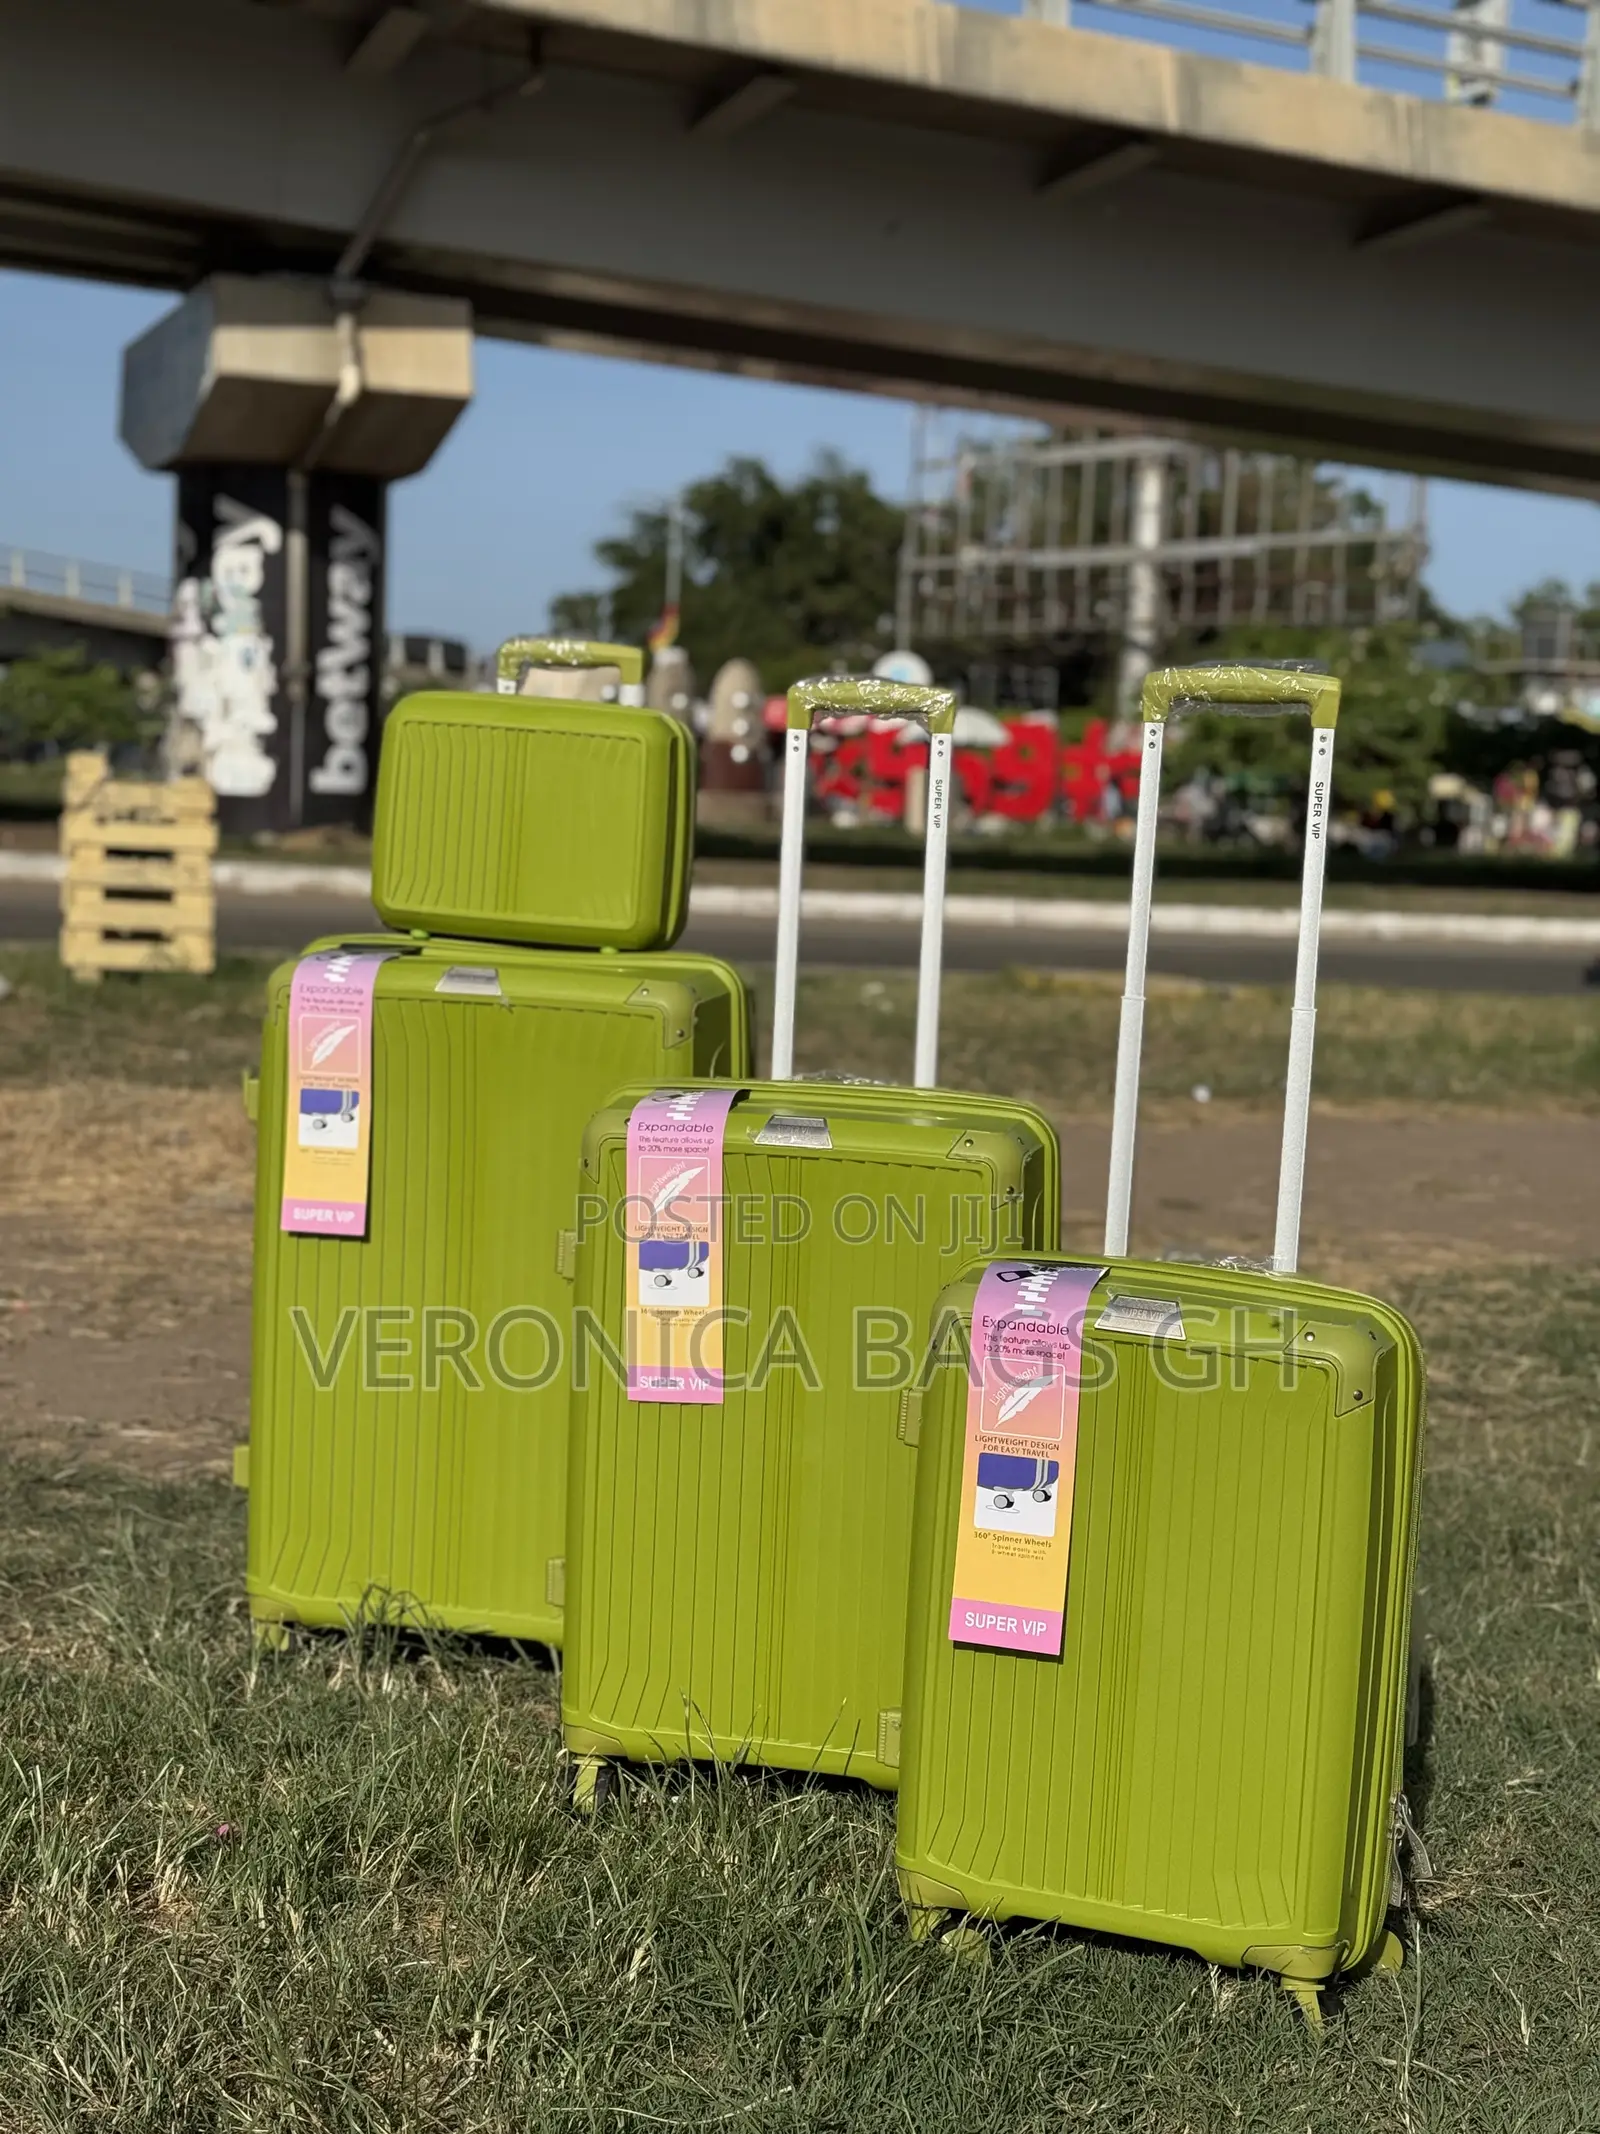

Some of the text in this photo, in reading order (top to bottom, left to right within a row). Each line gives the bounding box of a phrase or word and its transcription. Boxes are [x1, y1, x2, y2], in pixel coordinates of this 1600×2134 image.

[308, 503, 379, 796] betway
[933, 779, 943, 829] SUPER VIP
[1312, 781, 1324, 839] SUPER VIP
[637, 1121, 714, 1133] Expandable
[293, 1207, 355, 1223] SUPER VIP
[982, 1315, 1070, 1336] Expandable
[983, 1343, 993, 1351] to
[994, 1344, 1011, 1354] 20%
[1012, 1347, 1034, 1356] more
[984, 1333, 997, 1342] This
[1032, 1338, 1057, 1348] allows
[1059, 1342, 1071, 1350] up
[639, 1376, 711, 1391] SUPER VIP
[988, 1365, 1038, 1406] Lightweight
[974, 1434, 1060, 1451] LIGHTWEIGHT DESIGN
[983, 1443, 1050, 1458] FOR EASY TRAVEL
[992, 1533, 1022, 1544] Spinner
[1024, 1537, 1052, 1548] Wheels
[965, 1611, 1047, 1637] SUPER VIP
